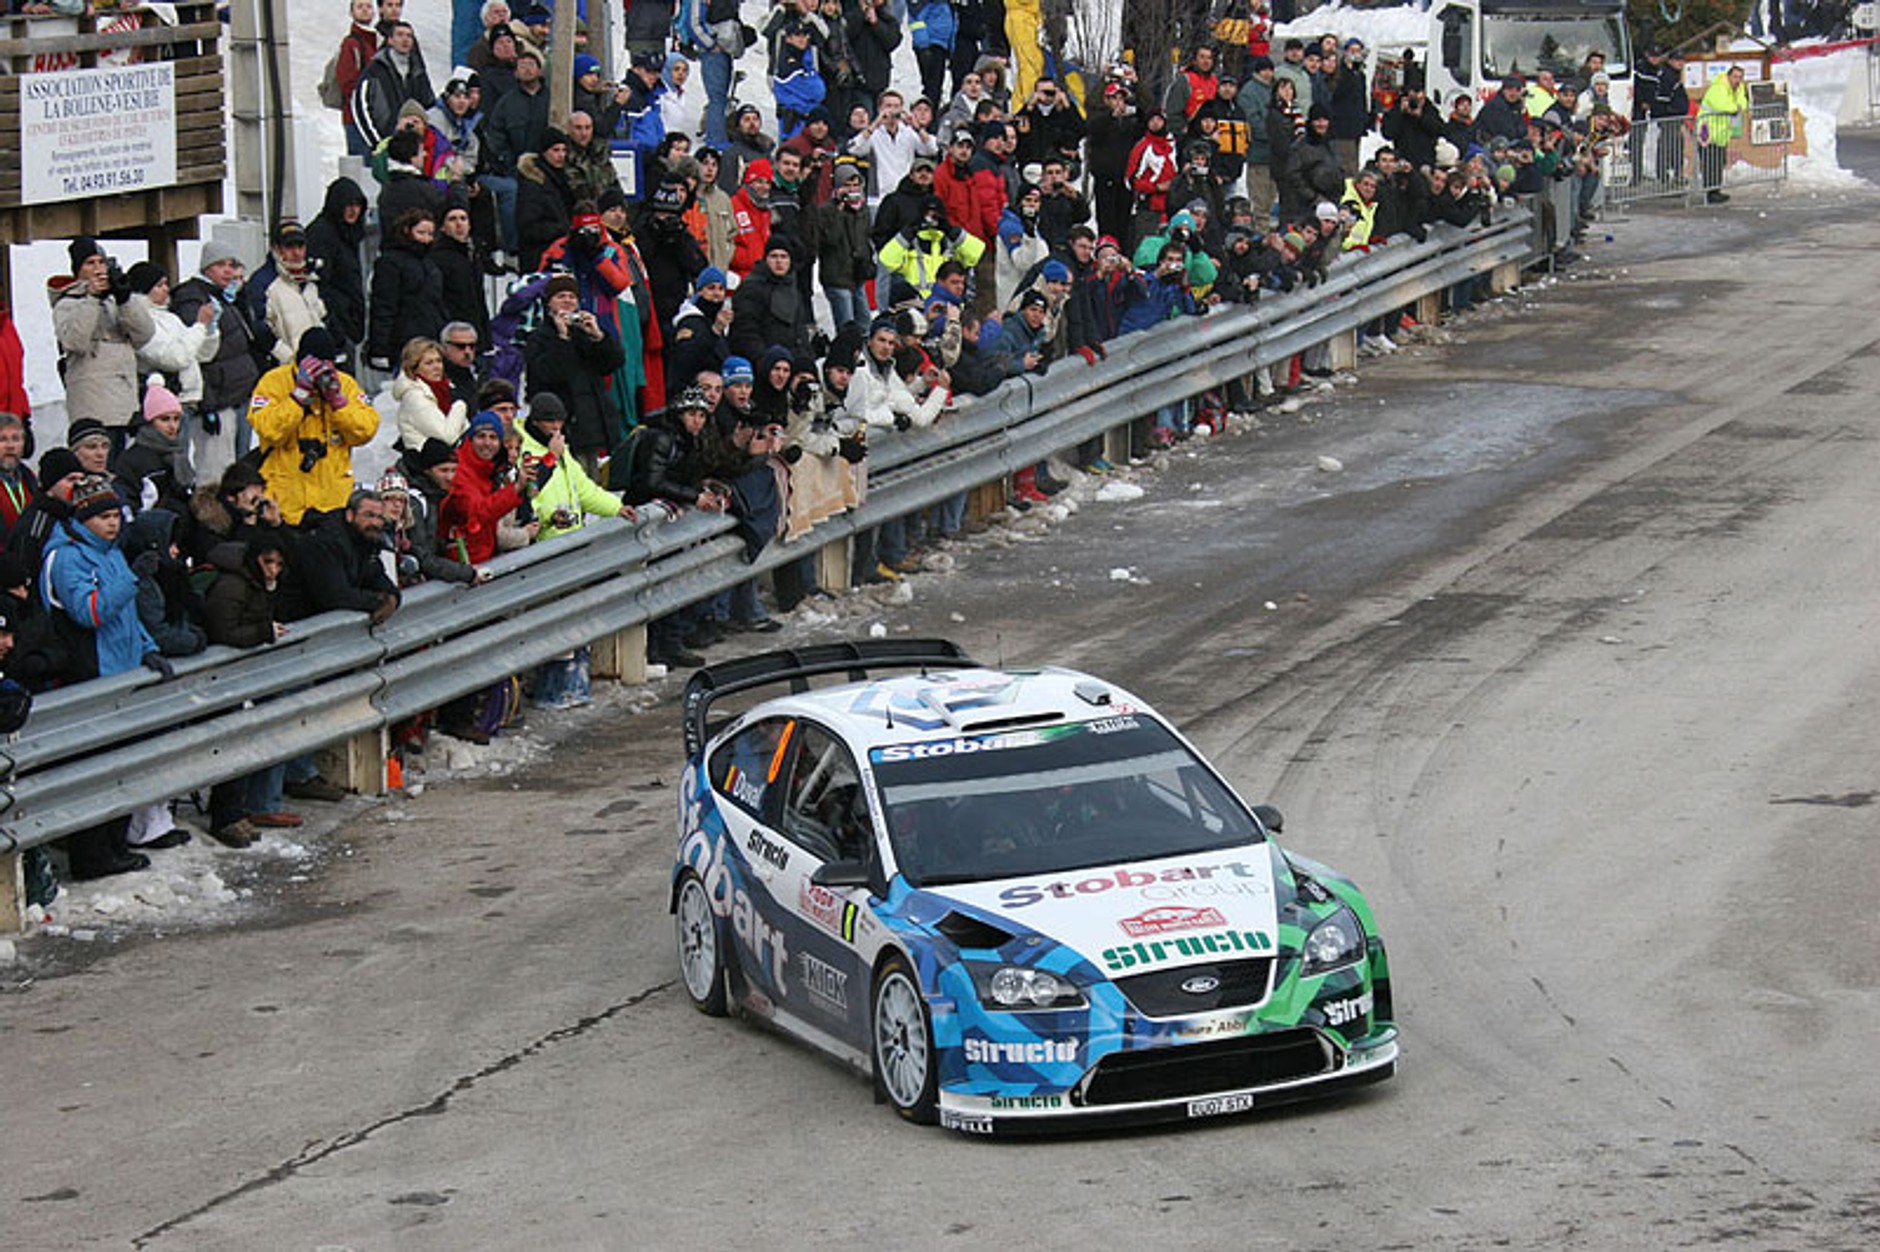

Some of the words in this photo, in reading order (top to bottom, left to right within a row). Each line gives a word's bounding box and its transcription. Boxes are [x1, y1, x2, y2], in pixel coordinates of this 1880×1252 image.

[26, 74, 102, 100] ASSOCIATION
[104, 69, 157, 92] SPORTIVE
[158, 67, 171, 87] DE
[44, 101, 60, 119] LA
[999, 861, 1255, 909] Stobart
[1140, 879, 1271, 902] Group
[1101, 929, 1272, 970] Structo
[964, 1037, 1079, 1063] Structo
[992, 1095, 1062, 1109] Structo
